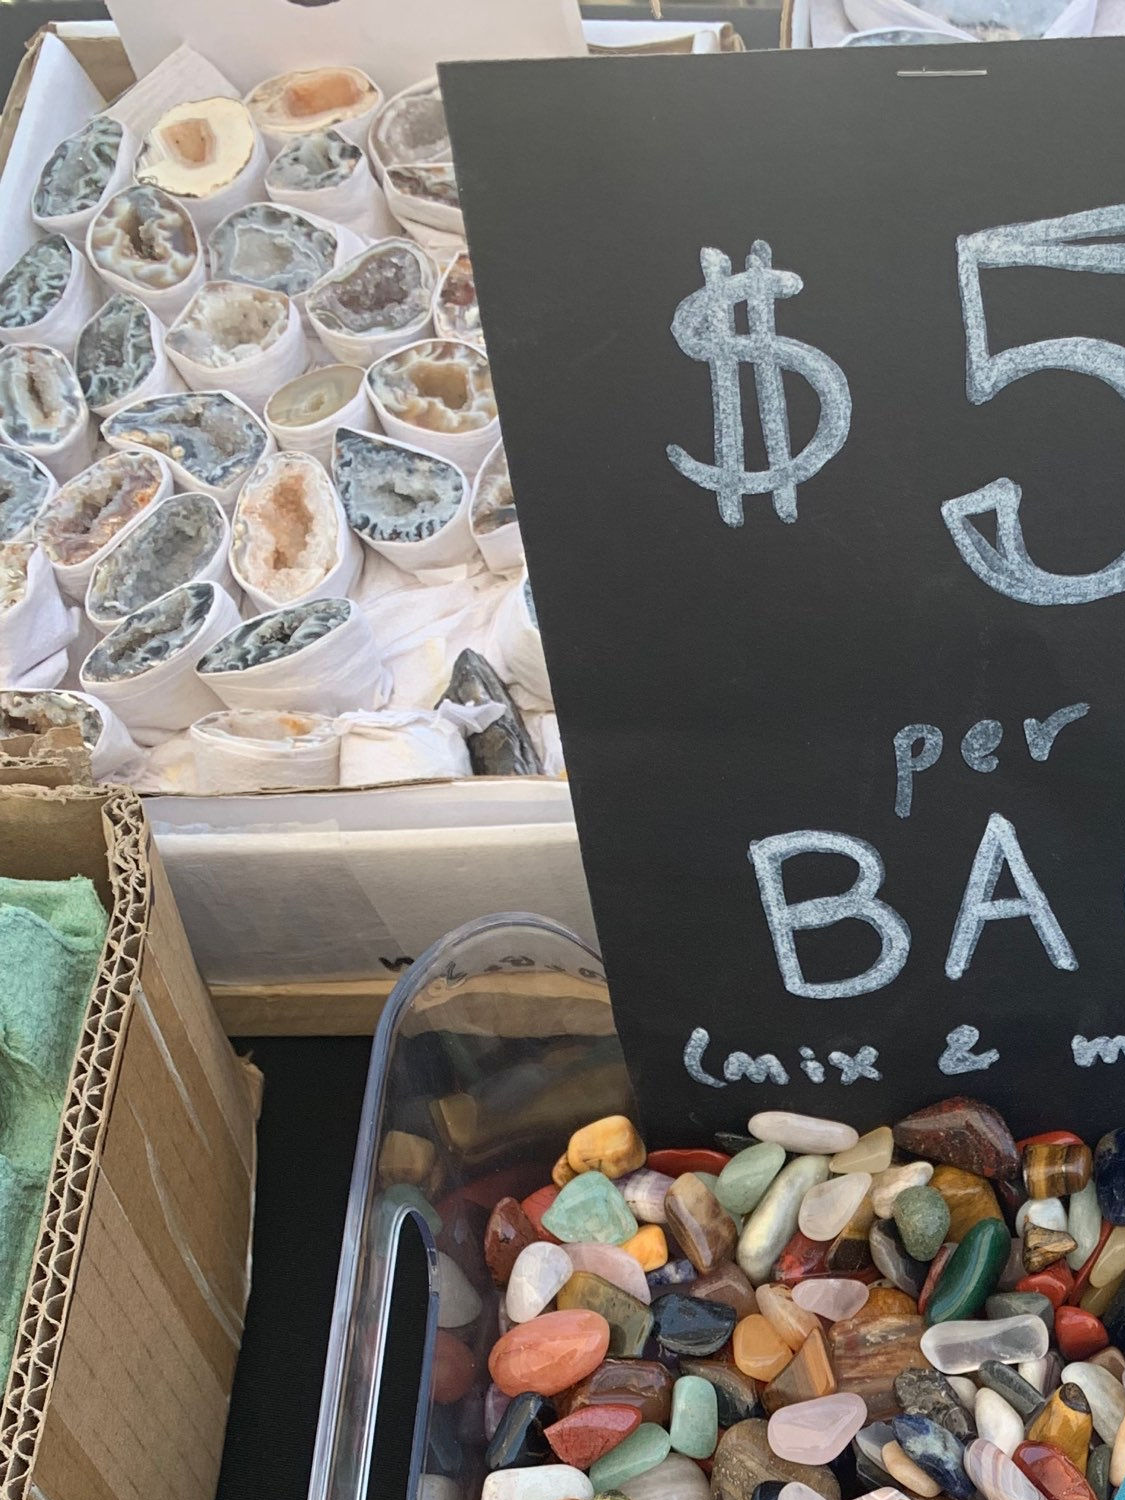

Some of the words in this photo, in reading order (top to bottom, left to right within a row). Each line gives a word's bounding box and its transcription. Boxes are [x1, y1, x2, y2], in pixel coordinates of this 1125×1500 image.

[892, 701, 1089, 817] per
[682, 1026, 883, 1087] (mix
[938, 1023, 1001, 1076] &
